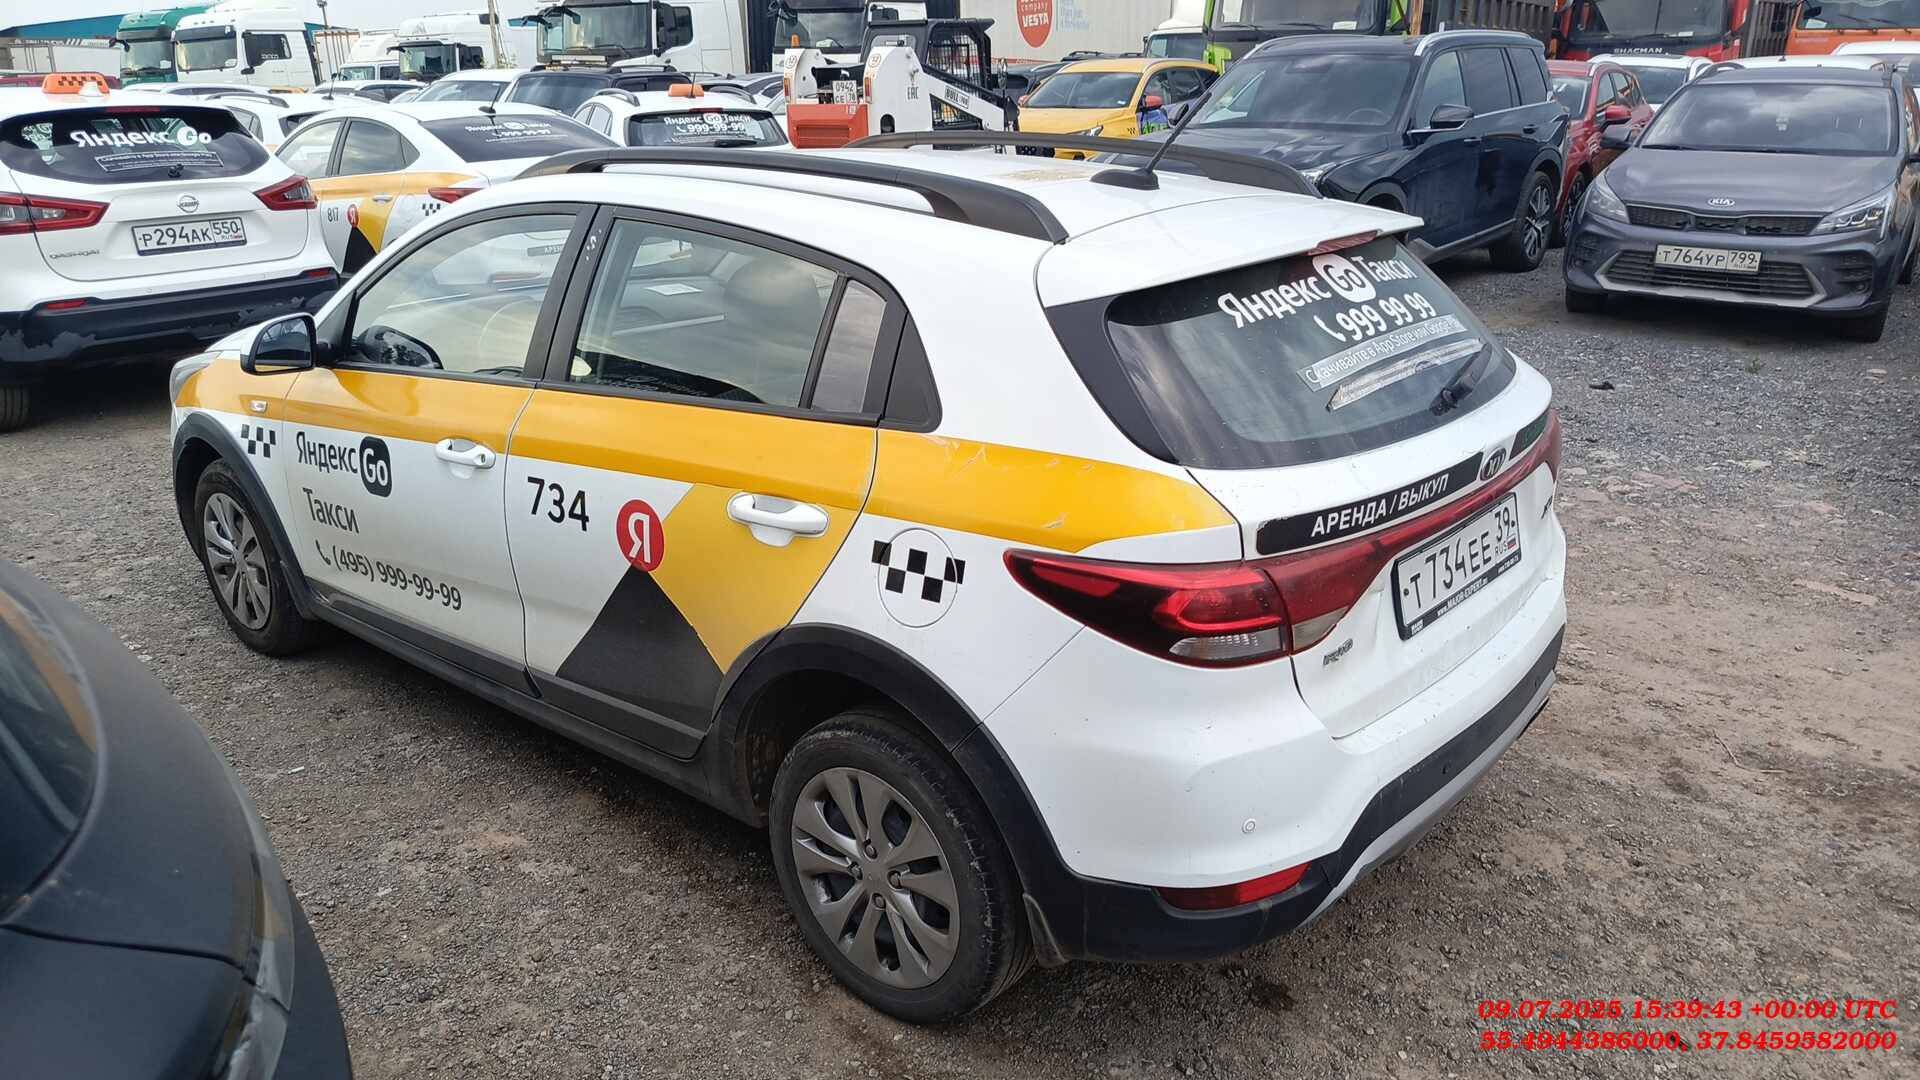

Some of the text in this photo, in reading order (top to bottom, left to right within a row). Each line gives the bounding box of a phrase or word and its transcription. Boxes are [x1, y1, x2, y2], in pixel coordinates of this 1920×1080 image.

[1022, 12, 1049, 28] VESTA
[69, 126, 213, 149] Яндекс Go
[687, 122, 745, 133] 999-99-99
[327, 207, 340, 223] 817
[1712, 198, 1731, 207] KIA
[141, 220, 239, 248] Р294АК 550
[1662, 248, 1755, 266] Т764УР 799
[1217, 255, 1420, 329] Яндекс Go Такси
[1336, 291, 1437, 341] 999 99 99
[295, 430, 391, 492] Яндекс Go
[302, 486, 361, 535] Такси
[527, 476, 590, 532] 734
[1311, 497, 1388, 538] АРЕНДА
[1398, 473, 1449, 513] ВЫКУП
[332, 544, 463, 611] (495) 999-99-99
[1409, 530, 1492, 609] Т734ЕЕ
[1494, 506, 1510, 542] 39
